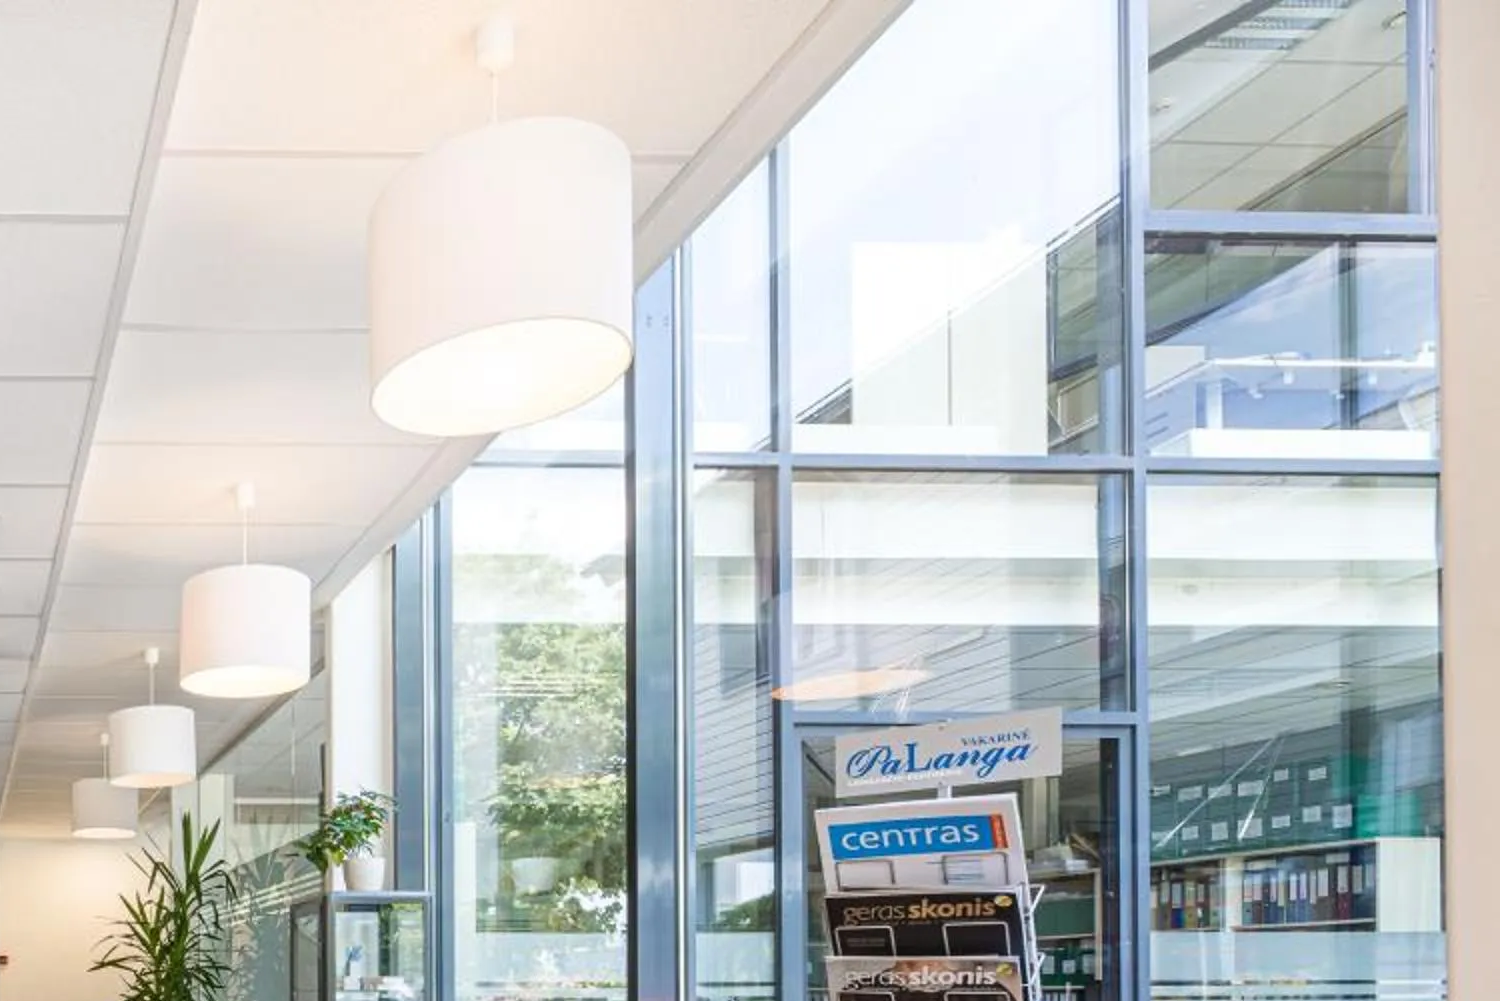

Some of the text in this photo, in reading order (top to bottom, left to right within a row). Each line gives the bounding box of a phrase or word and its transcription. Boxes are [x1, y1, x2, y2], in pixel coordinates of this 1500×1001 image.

[840, 823, 980, 851] centras
[842, 897, 996, 926] geras skonis
[843, 965, 997, 990] geras skonis
